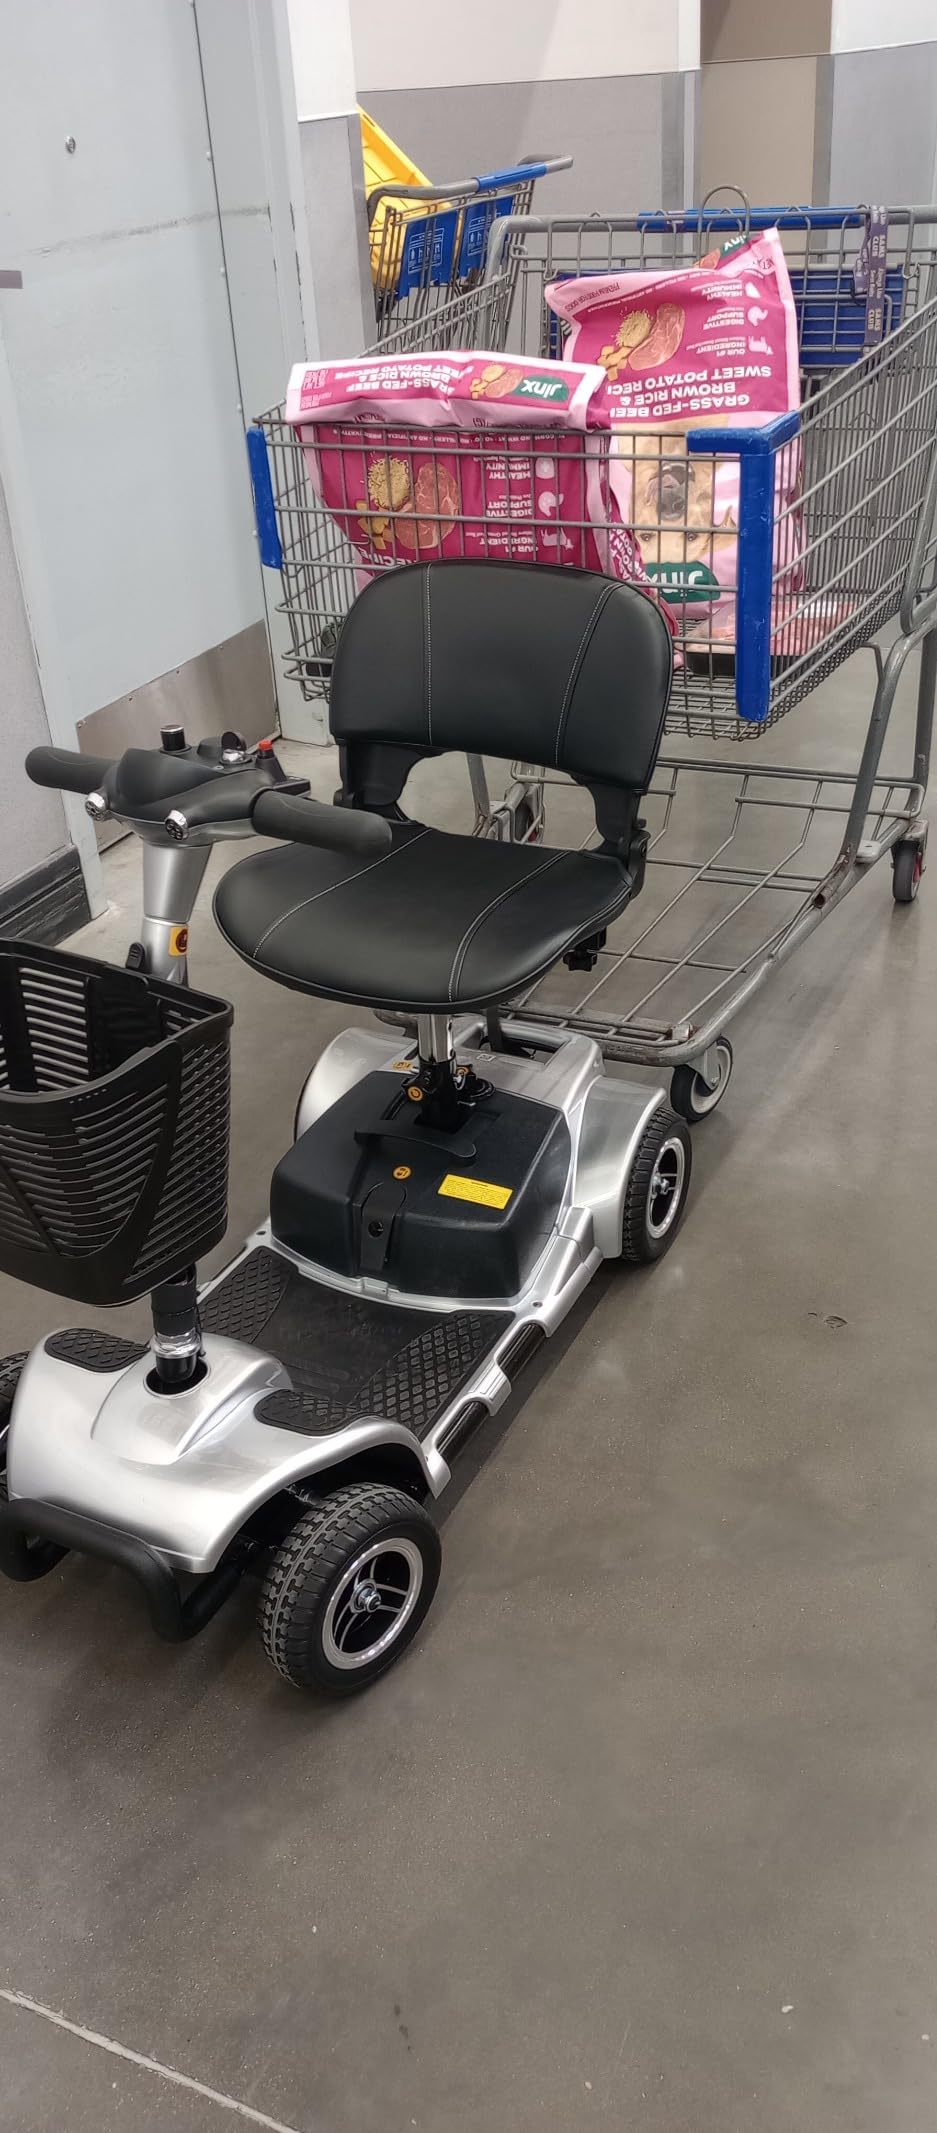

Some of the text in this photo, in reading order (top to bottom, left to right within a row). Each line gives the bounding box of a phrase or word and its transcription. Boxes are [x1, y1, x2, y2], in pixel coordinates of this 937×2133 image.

[701, 284, 743, 296] IMMUNITY
[707, 291, 743, 301] HEALTHY
[706, 312, 744, 322] SUPPORT
[703, 319, 745, 330] DIGESTIVE
[695, 342, 746, 354] INGREDIENT
[370, 371, 399, 382] RICE
[400, 370, 451, 383] BROWN
[711, 366, 772, 380] SWEET
[645, 370, 708, 389] POTATO
[346, 381, 380, 392] BEEF
[620, 382, 736, 406] BROWN RICE &
[652, 395, 750, 416] GRASS-FED
[486, 463, 530, 471] IMMNITY
[489, 471, 530, 479] HEATHY
